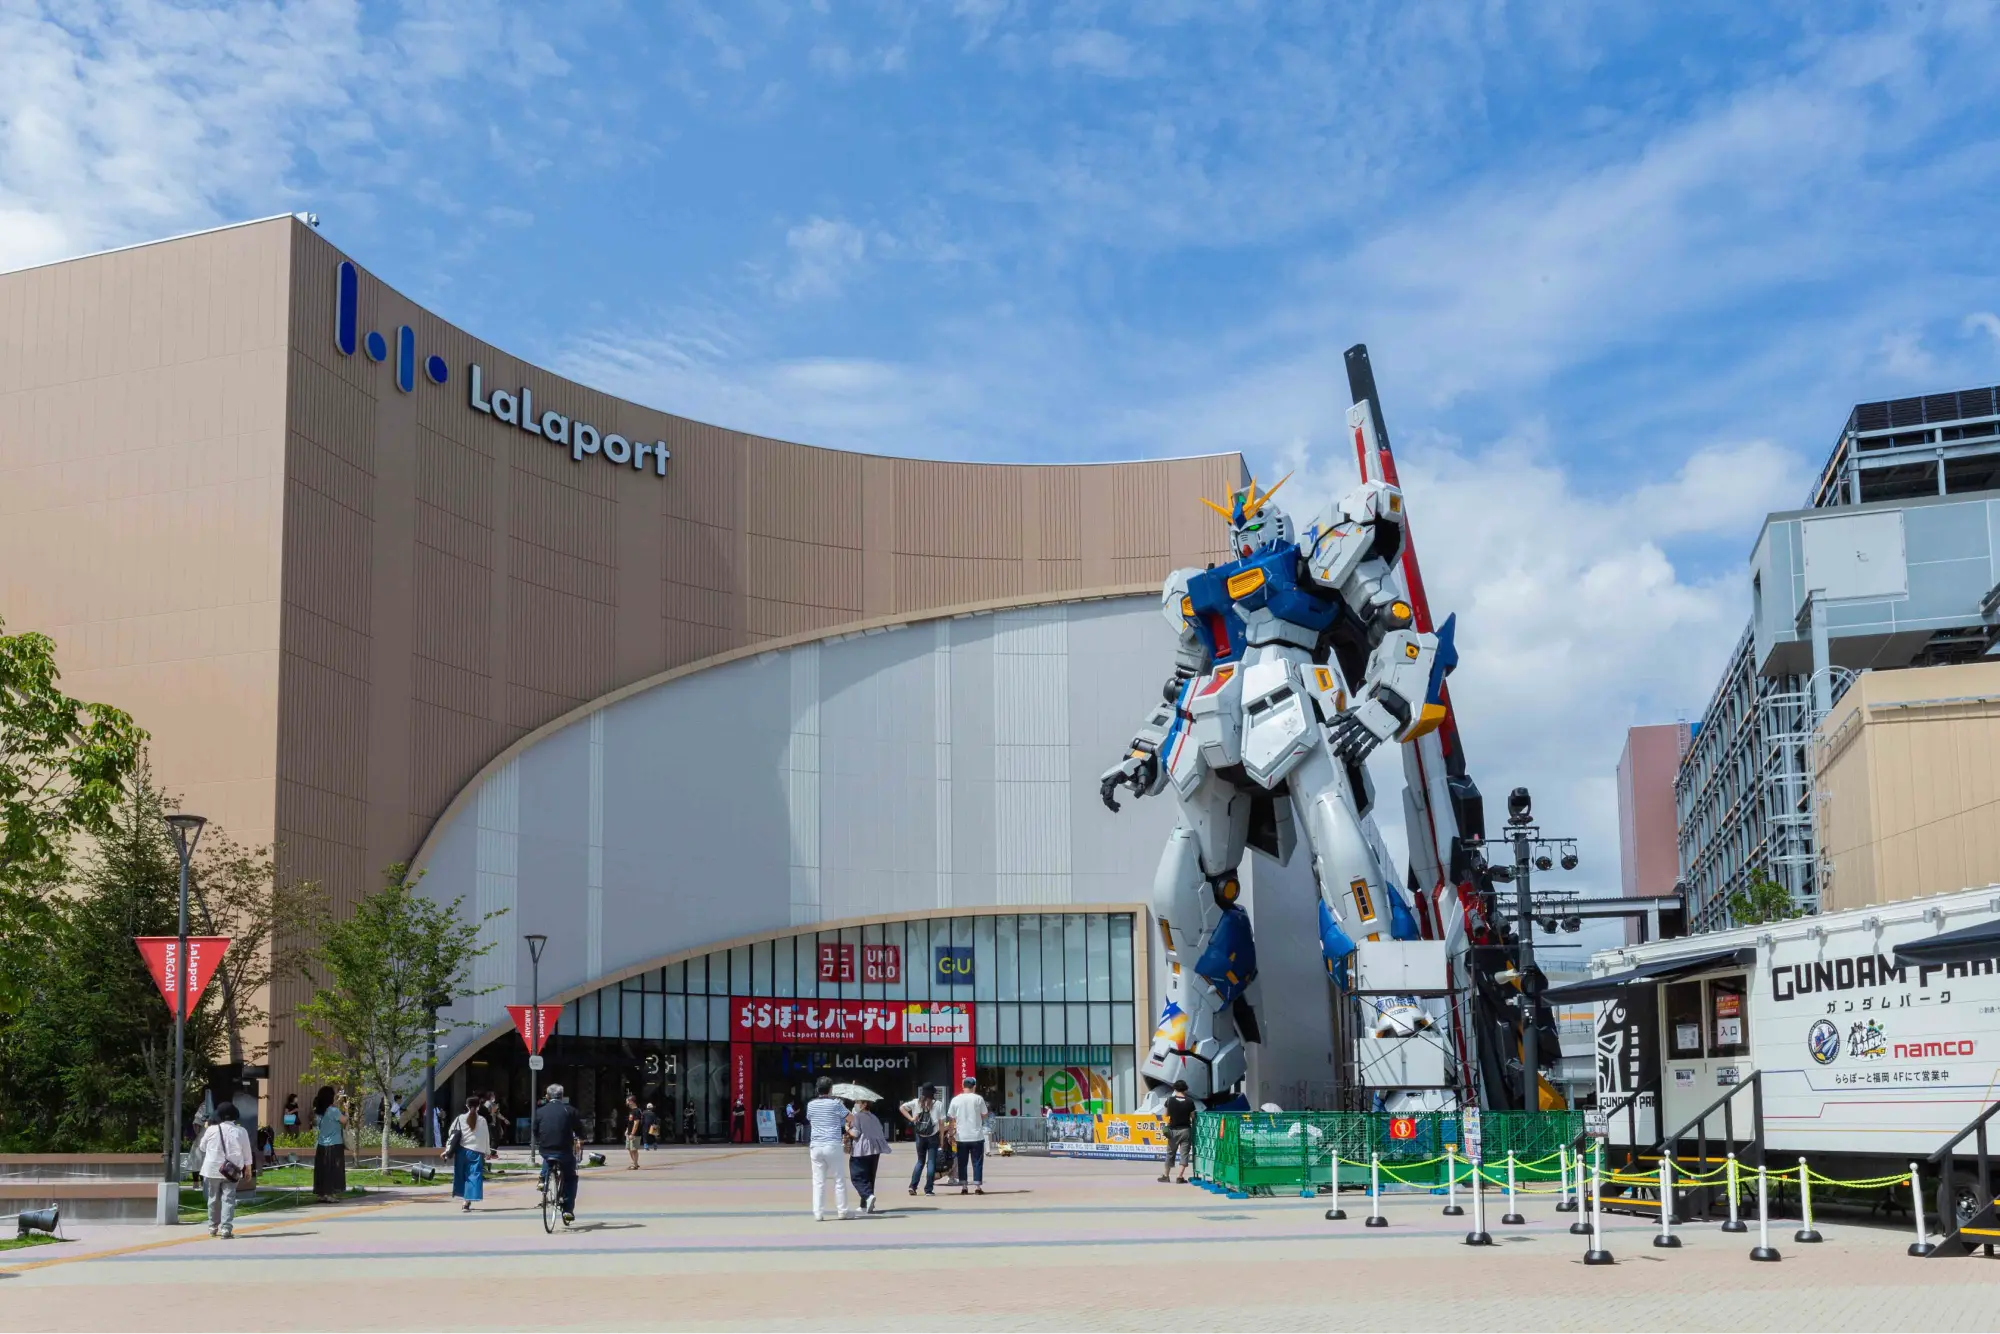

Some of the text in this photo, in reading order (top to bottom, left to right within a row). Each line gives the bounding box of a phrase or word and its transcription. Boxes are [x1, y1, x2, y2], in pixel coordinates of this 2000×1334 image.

[468, 362, 671, 477] LaLaport
[867, 949, 894, 963] UNI
[165, 943, 176, 992] BARGAIN
[187, 943, 200, 992] LaLaport
[867, 965, 895, 980] QLO
[938, 956, 971, 974] GU
[1771, 953, 1907, 1002] GUNDAM
[1827, 991, 1951, 1014] ガンダムパーク
[740, 1002, 897, 1031] ららぽーとバーゲン
[782, 1031, 817, 1039] LaLaport
[908, 1022, 964, 1036] LaLaport
[1720, 1026, 1738, 1036] 入口
[1894, 1039, 1975, 1058] namco
[835, 1054, 910, 1071] LaLaport
[1835, 1070, 1950, 1084] ららぽーと福岡 4Fにて営業中
[1600, 1096, 1638, 1110] GUND
